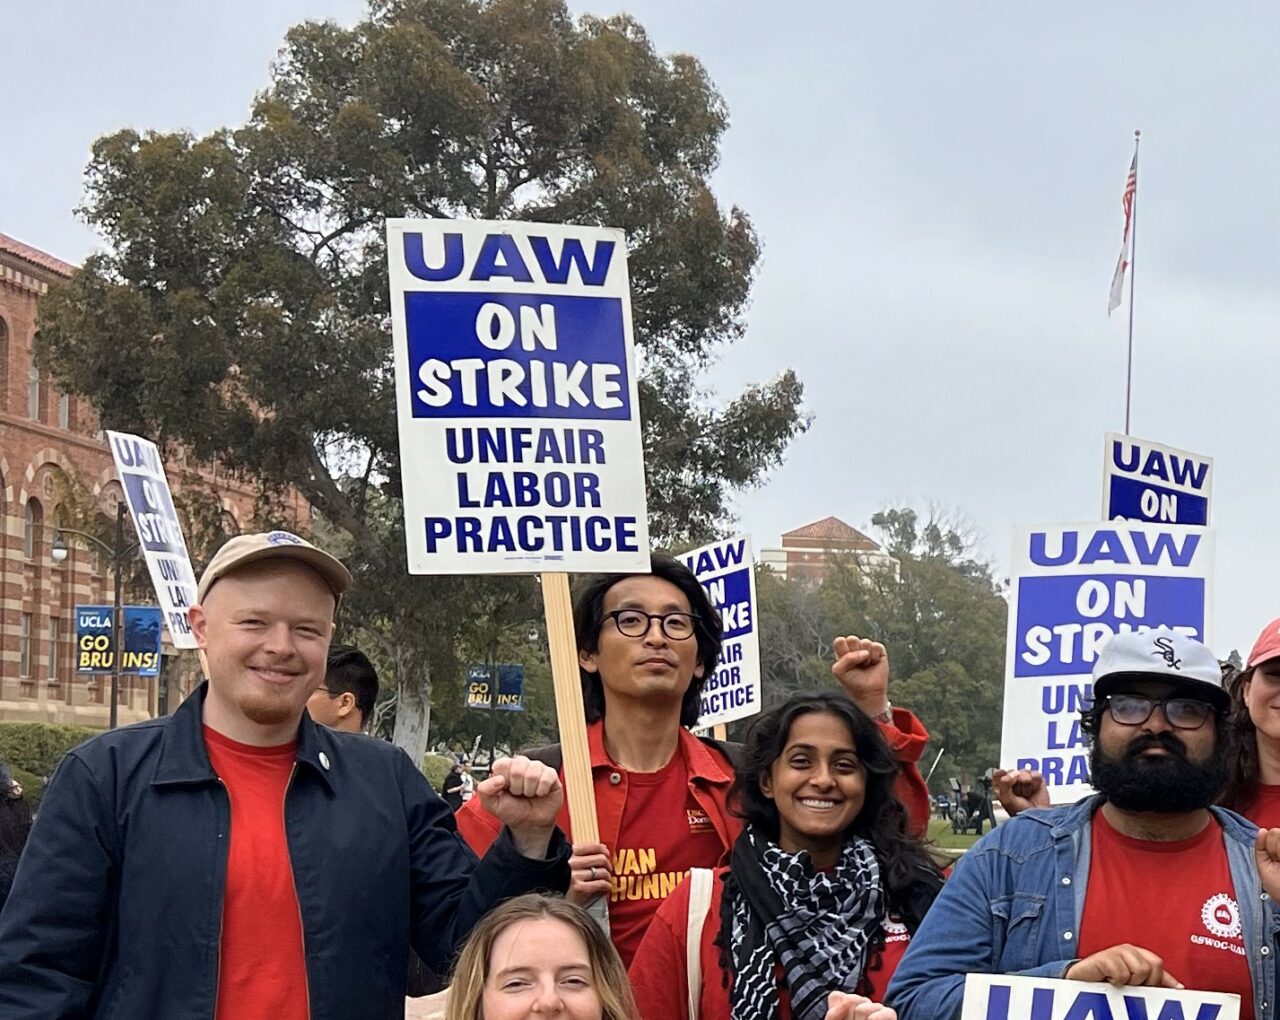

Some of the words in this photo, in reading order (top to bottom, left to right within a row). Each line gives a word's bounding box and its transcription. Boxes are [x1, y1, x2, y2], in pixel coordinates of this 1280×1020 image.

[403, 232, 615, 286] UAW
[475, 302, 557, 351] ON
[418, 359, 623, 409] STRIKE
[446, 428, 605, 464] UNFAIR
[1112, 440, 1209, 489] UAW
[458, 472, 601, 508] LABOR
[1141, 488, 1177, 522] ON
[425, 517, 638, 553] PRACTICE
[1029, 530, 1201, 567] UAW
[1076, 579, 1146, 618] ON
[80, 616, 111, 628] UCLA
[80, 635, 109, 651] GO
[717, 643, 743, 665] AIR
[1022, 623, 1198, 665] STR
[470, 682, 489, 693] GO
[703, 666, 740, 693] BOR
[701, 684, 754, 716] ACTICE
[613, 848, 656, 875] VAN
